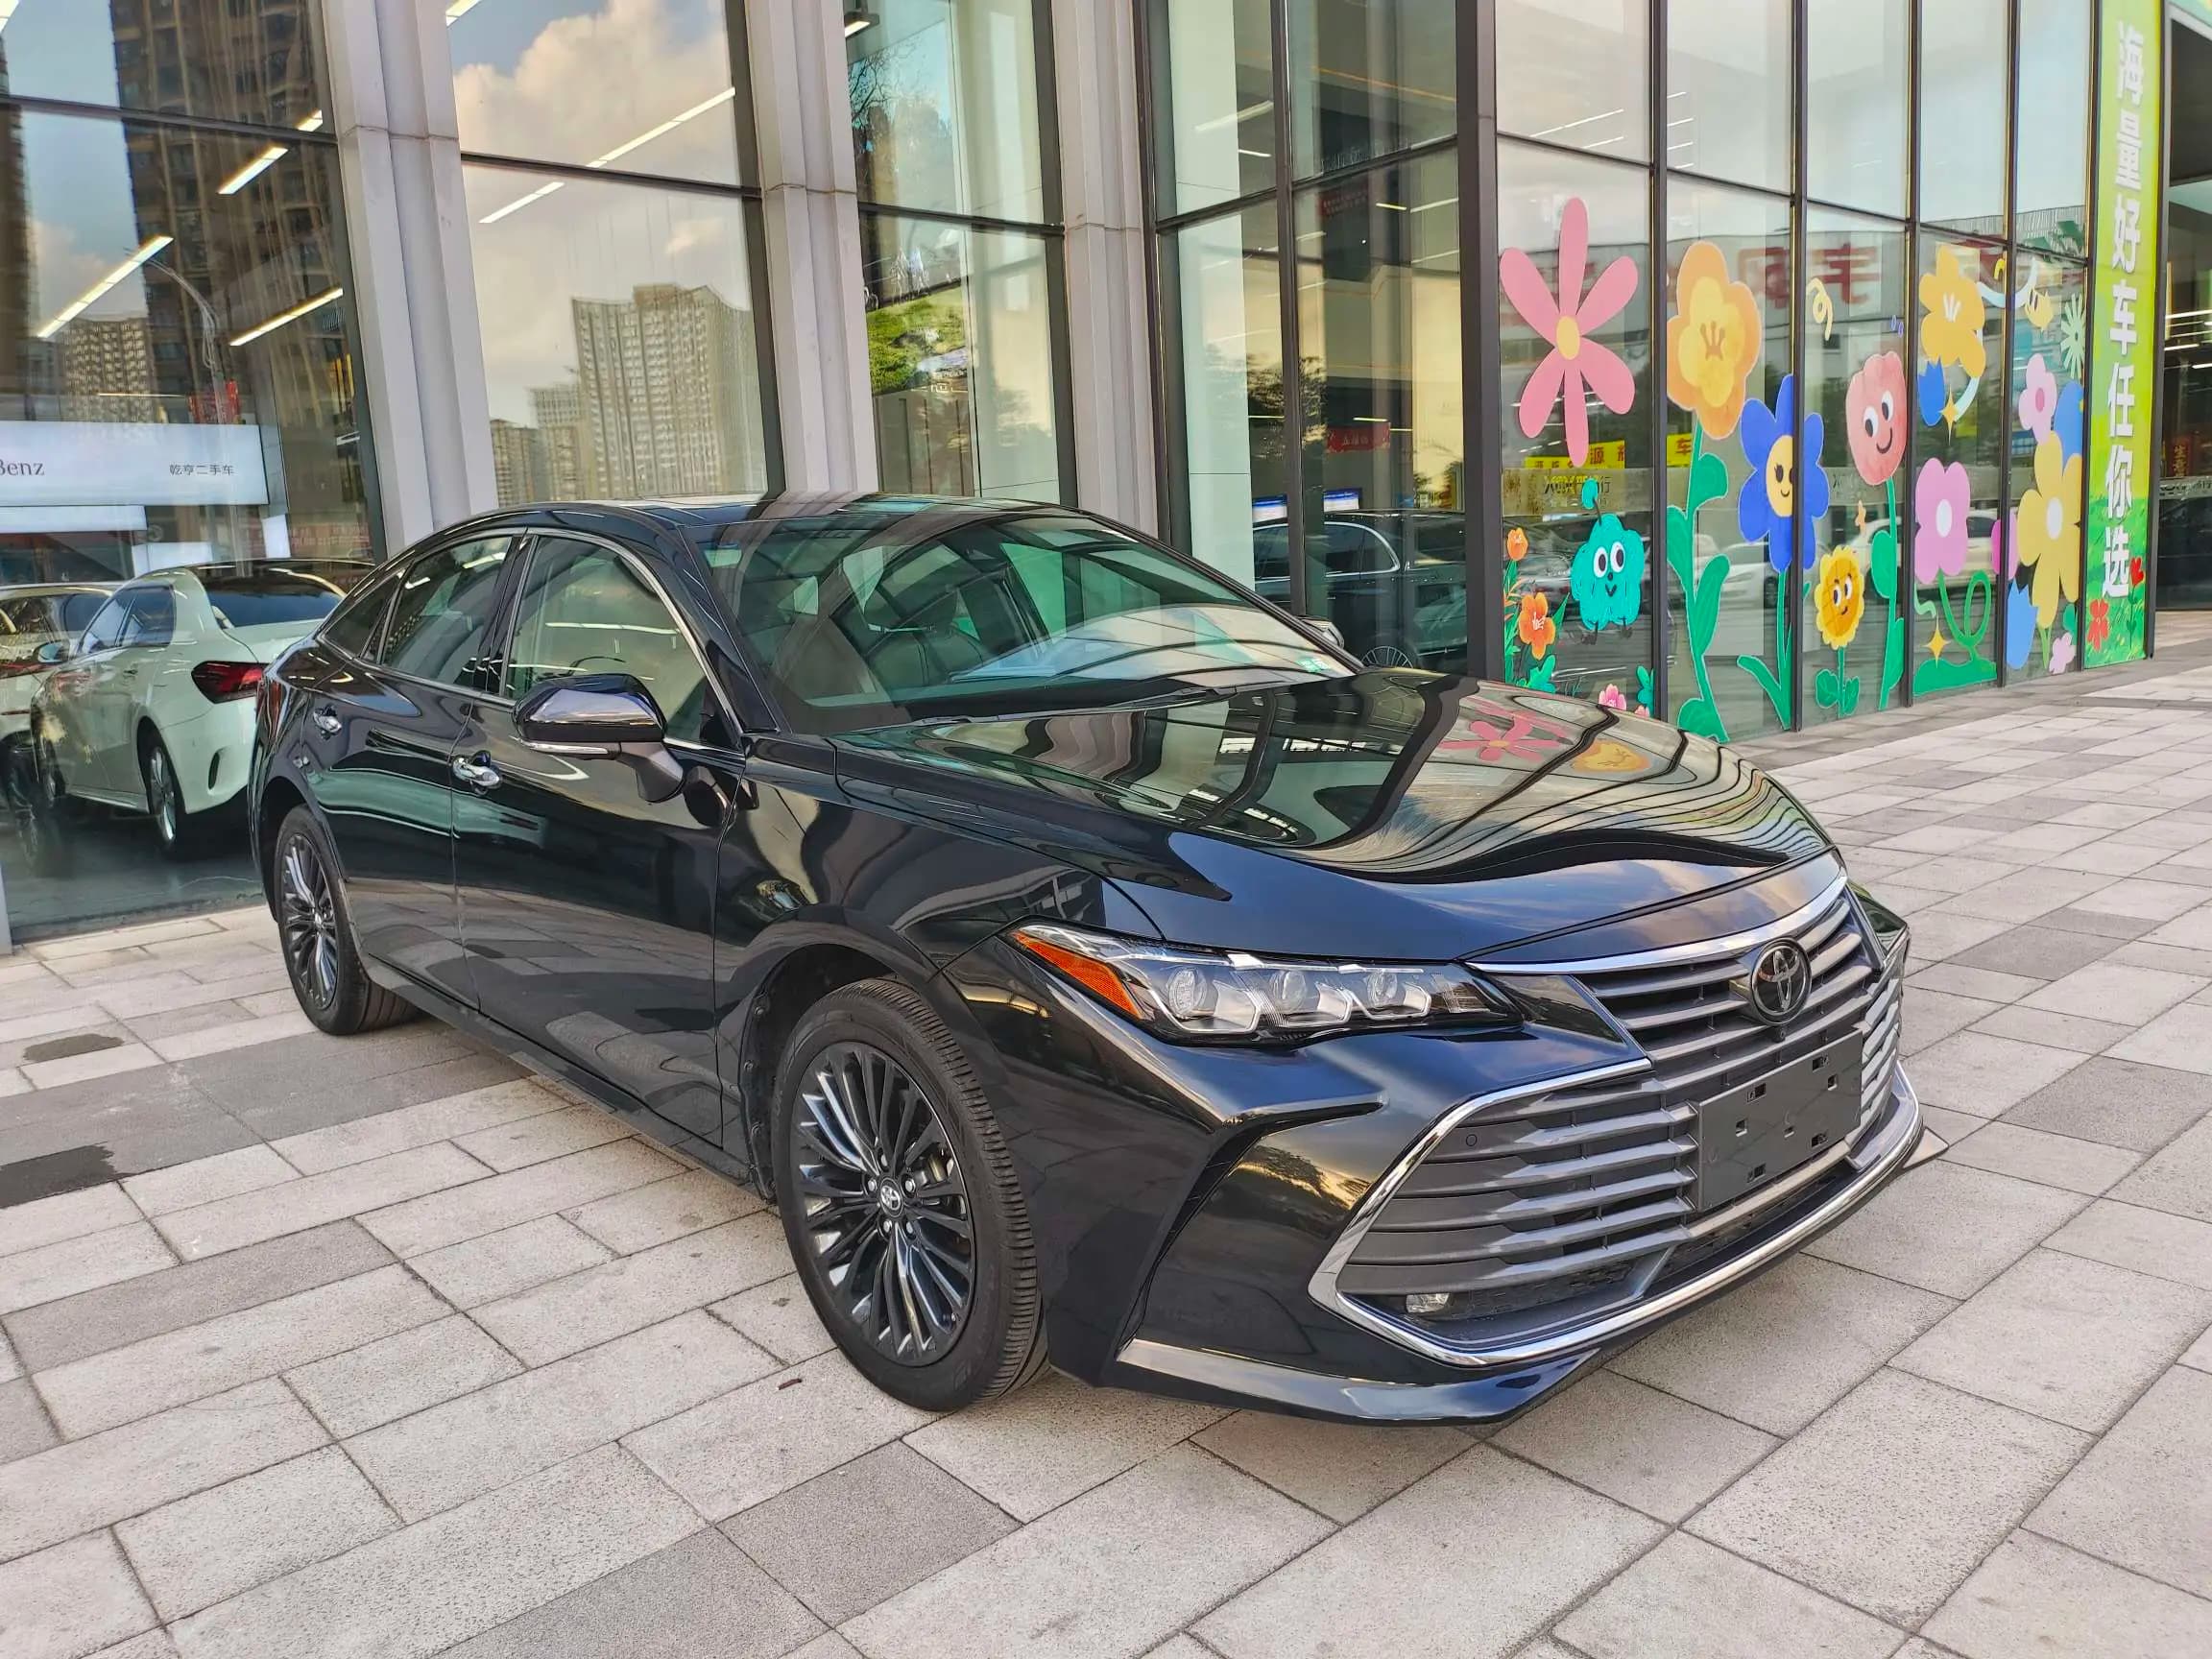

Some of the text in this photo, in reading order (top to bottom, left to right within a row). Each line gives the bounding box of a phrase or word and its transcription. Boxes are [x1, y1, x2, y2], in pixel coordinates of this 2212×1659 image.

[2103, 20, 2144, 598] 海量好车任你选
[169, 463, 234, 476] 乾亨二手车
